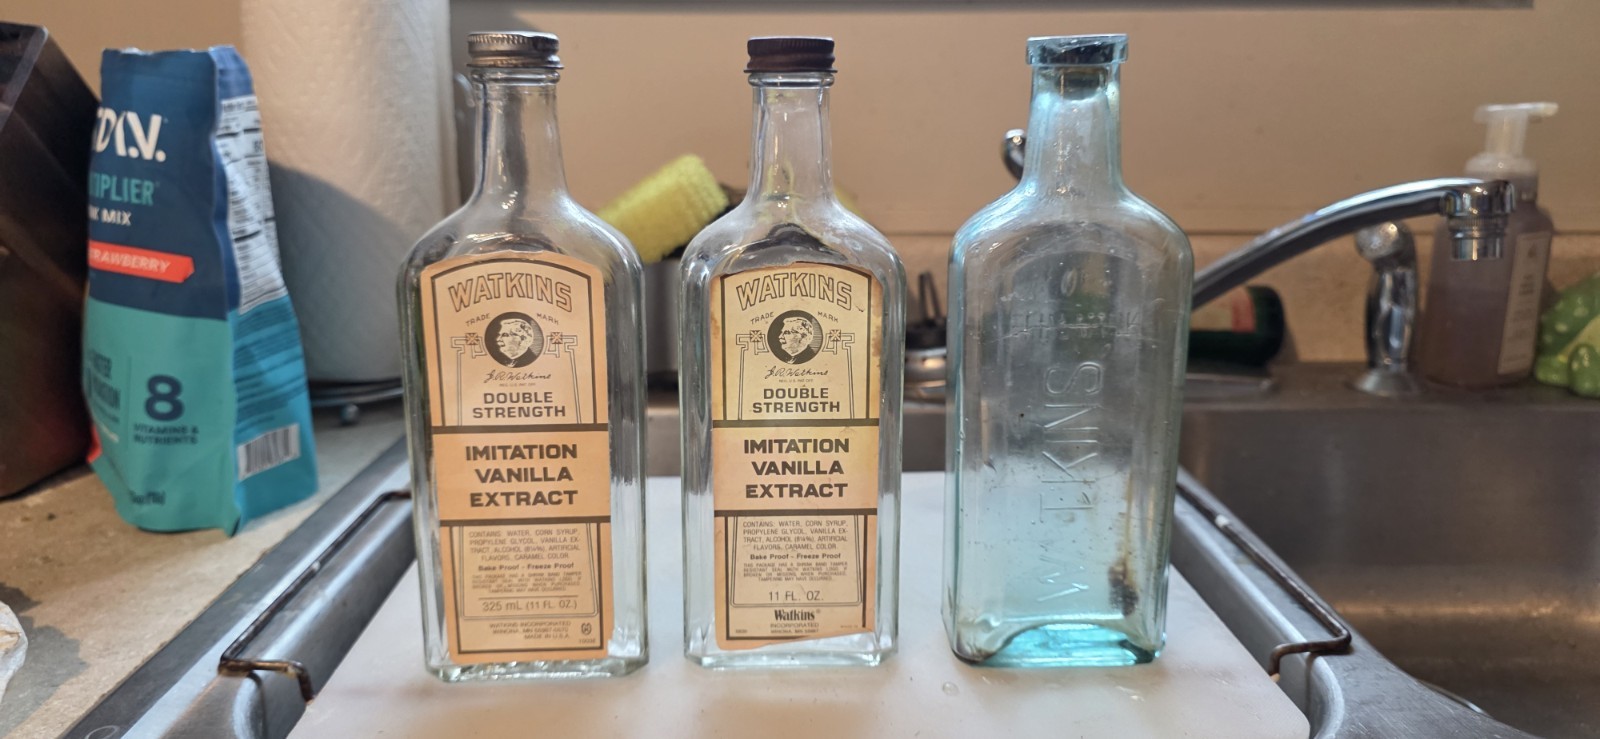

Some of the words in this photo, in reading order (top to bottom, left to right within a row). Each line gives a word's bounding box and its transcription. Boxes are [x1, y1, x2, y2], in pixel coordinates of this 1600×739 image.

[102, 207, 131, 226] MIX
[448, 272, 572, 313] WATKINS
[736, 272, 852, 312] WATKINS
[465, 313, 490, 327] TRADE
[536, 313, 559, 326] MARK
[750, 311, 774, 325] TRADE
[817, 311, 839, 323] MARK
[145, 374, 184, 421] 8
[484, 392, 553, 404] DOUBLE
[763, 387, 829, 400] DOUBLE
[472, 406, 566, 419] STRENGTH
[752, 401, 840, 413] STRENGTH
[465, 444, 577, 461] IMITATION
[744, 438, 850, 454] IMITATION
[474, 466, 573, 484] VANILLA
[751, 460, 844, 476] VANILLA
[469, 490, 578, 507] EXTRACT
[745, 483, 848, 499] EXTRACT
[469, 538, 507, 546] PROPYLENE
[769, 591, 779, 601] 11
[785, 590, 801, 601] FL.
[806, 590, 824, 601] OZ.
[482, 601, 503, 612] 325
[505, 600, 523, 611] mL
[526, 600, 540, 611] (11
[543, 600, 557, 609] FL.
[559, 599, 578, 610] OZ.)
[774, 609, 815, 621] Watkins
